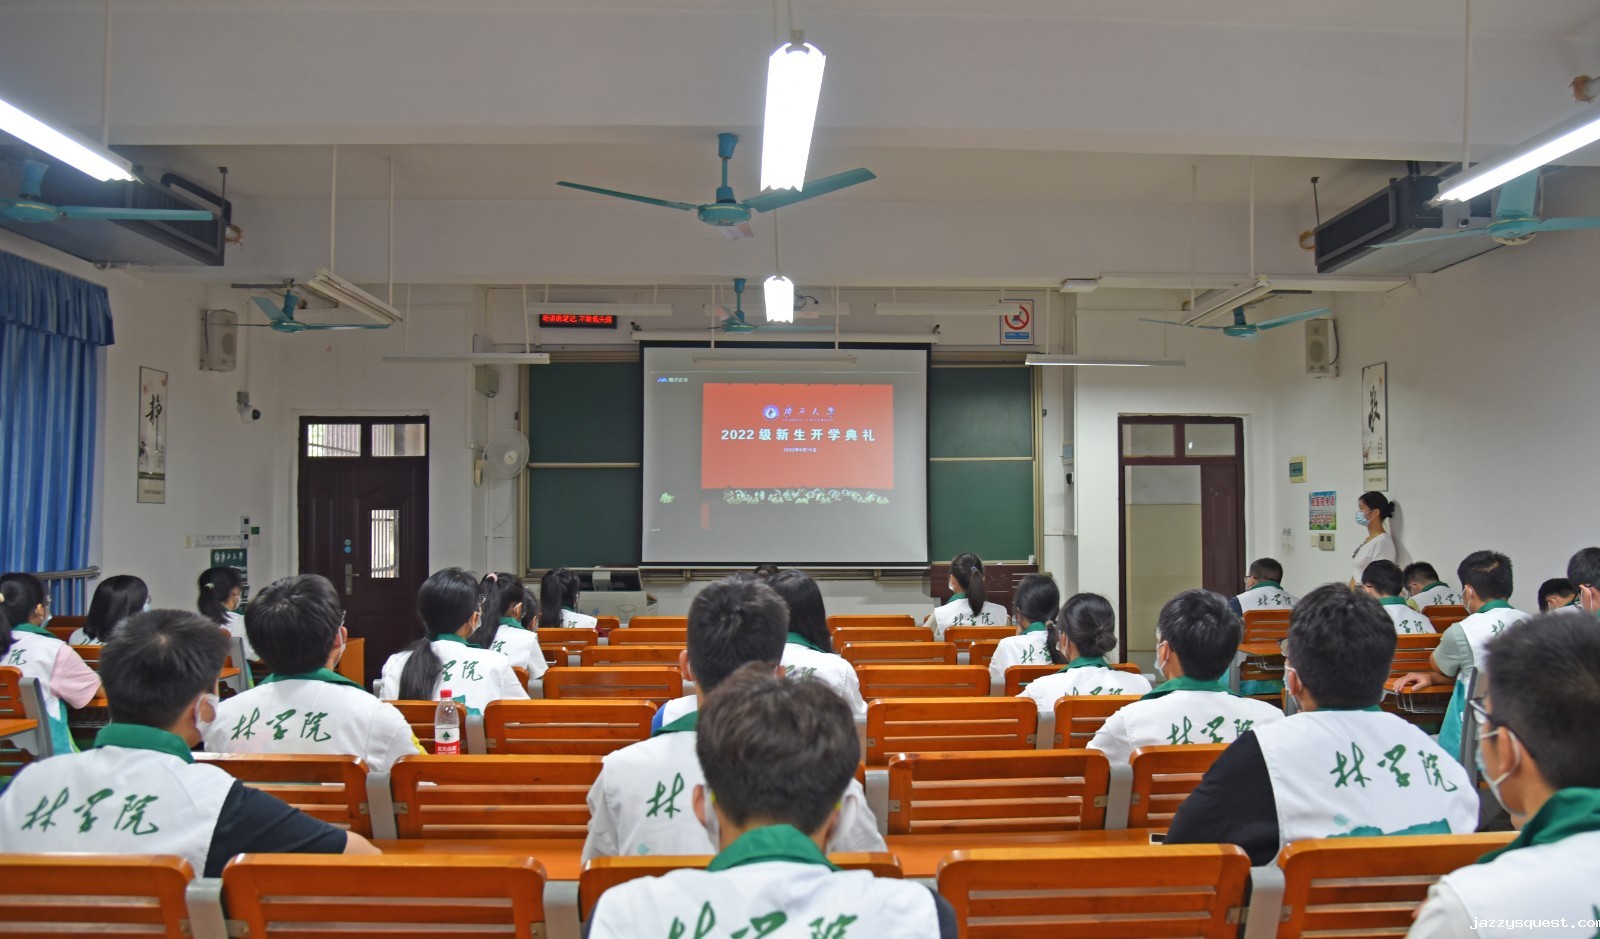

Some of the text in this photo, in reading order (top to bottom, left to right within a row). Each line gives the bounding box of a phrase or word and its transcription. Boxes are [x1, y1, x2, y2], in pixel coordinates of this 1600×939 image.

[720, 428, 876, 442] 2022级新生开学典礼
[1433, 594, 1462, 605] 林学
[231, 707, 332, 742] 林学院
[1329, 741, 1458, 792] 林学院
[21, 786, 159, 835] 林学院
